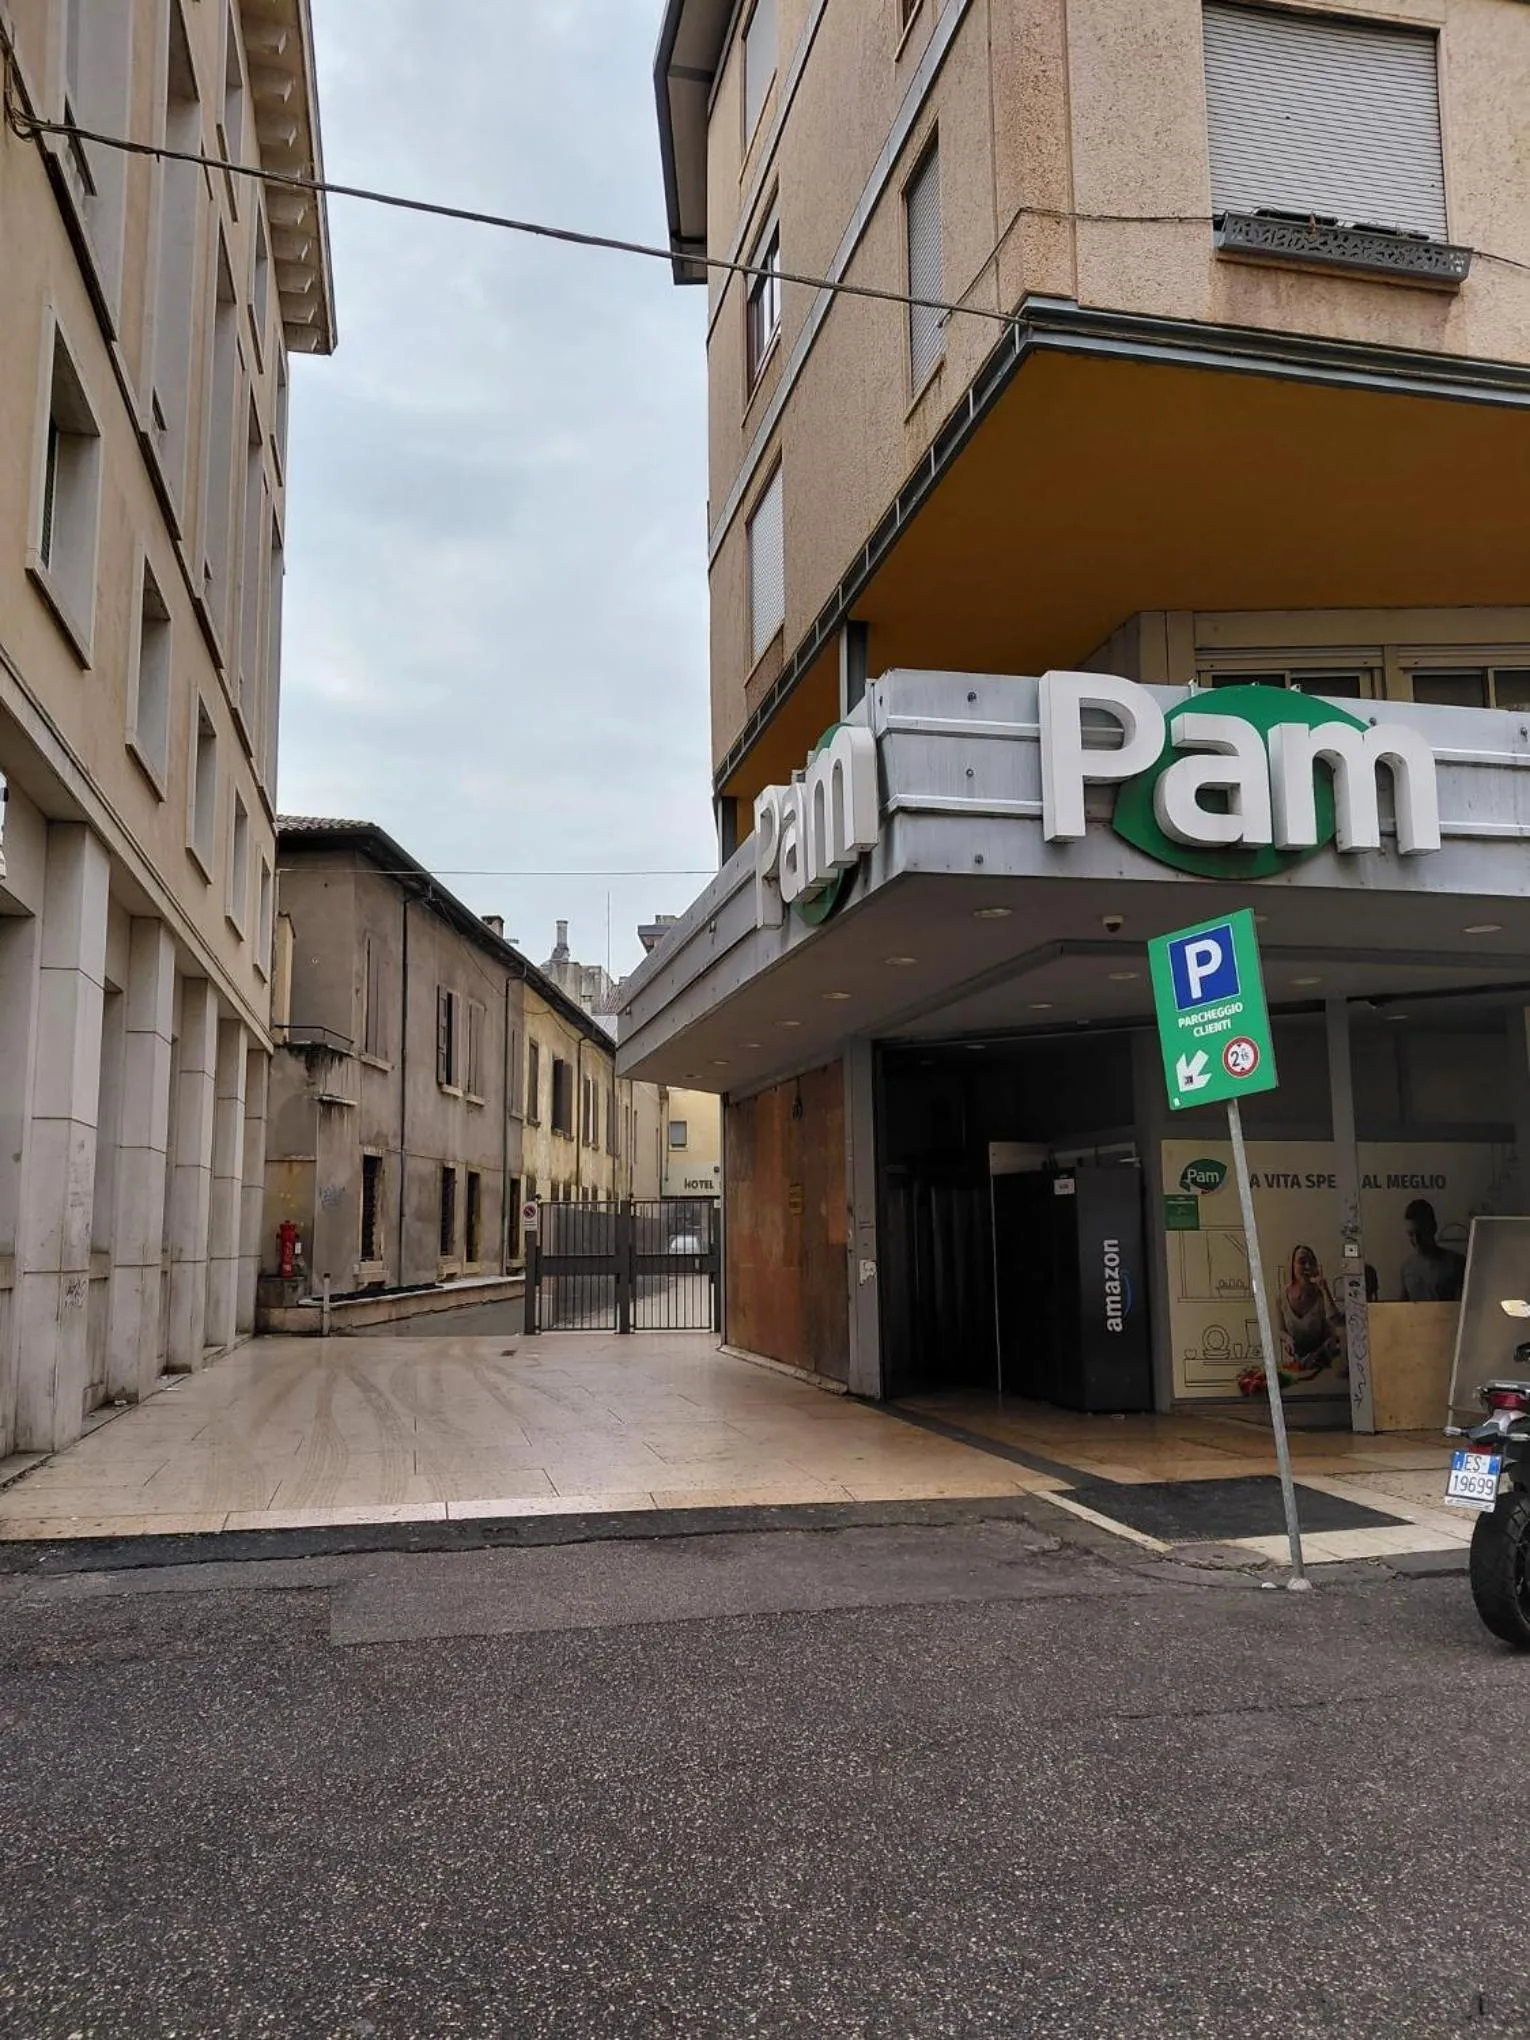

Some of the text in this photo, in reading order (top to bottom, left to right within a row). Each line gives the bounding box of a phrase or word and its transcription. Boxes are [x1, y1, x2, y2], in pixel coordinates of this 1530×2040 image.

[1039, 670, 1441, 855] Pam
[753, 726, 879, 928] Pam
[1184, 939, 1222, 999] P
[1178, 1002, 1243, 1028] PARCHEGGIO
[1193, 1021, 1231, 1037] CLIENTI
[1187, 1168, 1220, 1184] Pam
[1250, 1174, 1447, 1189] A VITA SPE AL MEGLIO
[1103, 1239, 1123, 1332] amazon
[1464, 1454, 1482, 1473] ES
[1453, 1475, 1494, 1496] 19699
